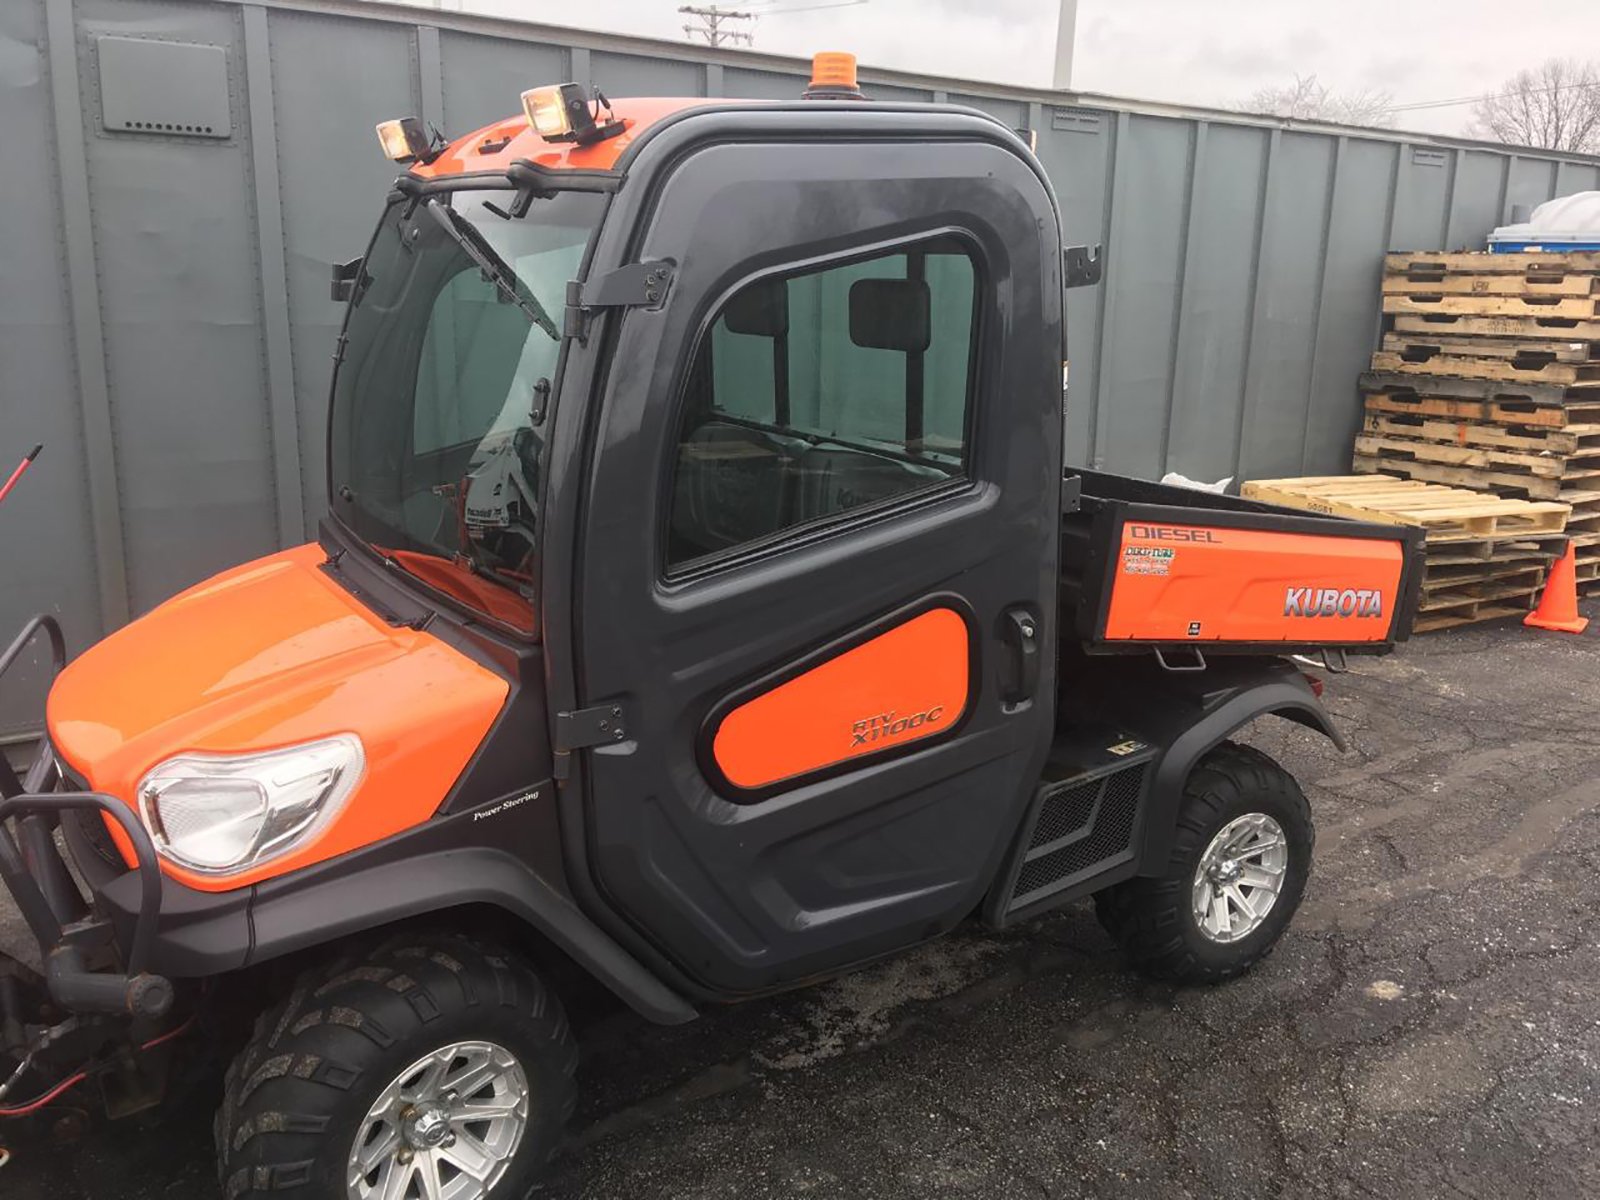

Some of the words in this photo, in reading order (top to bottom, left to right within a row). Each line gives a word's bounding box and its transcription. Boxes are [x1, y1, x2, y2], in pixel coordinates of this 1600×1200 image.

[1130, 526, 1223, 543] DIESEL
[1284, 587, 1382, 618] KUBOTA
[850, 706, 943, 747] X1100C
[853, 710, 896, 733] RTV
[474, 806, 503, 821] Power
[503, 791, 539, 810] Steering
